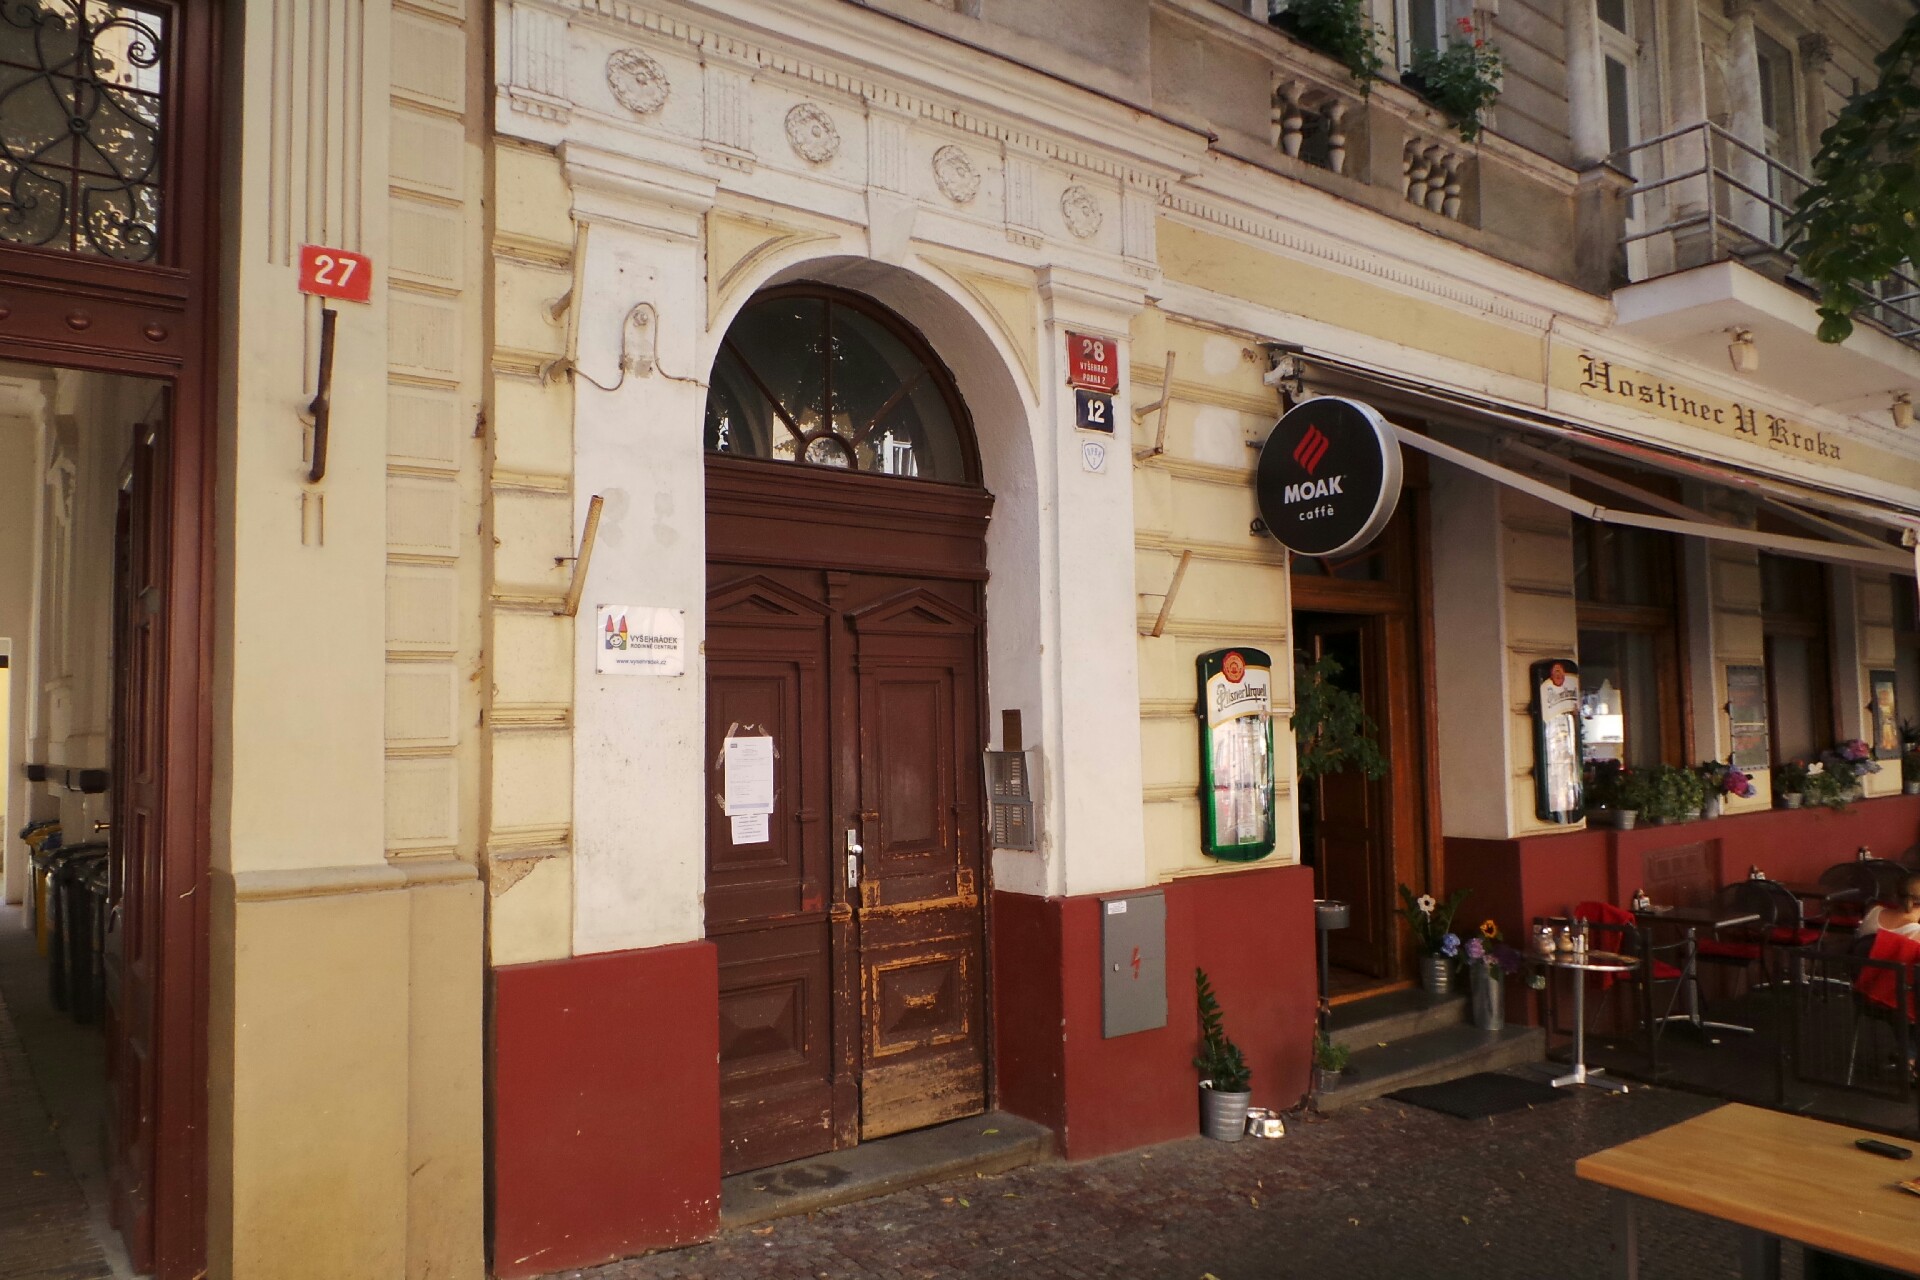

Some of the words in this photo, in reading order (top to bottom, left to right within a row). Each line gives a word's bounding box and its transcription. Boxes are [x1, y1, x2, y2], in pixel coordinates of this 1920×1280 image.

[314, 254, 358, 287] 27
[1082, 339, 1105, 362] 28
[1101, 376, 1106, 385] 2
[1087, 399, 1105, 423] 12
[1578, 354, 1726, 424] Hostinec
[1732, 402, 1759, 436] U
[1766, 413, 1841, 460] Kroka
[1284, 475, 1344, 504] MOAK
[1299, 504, 1334, 521] caffè
[630, 634, 677, 644] VYŠEHRÁDEK
